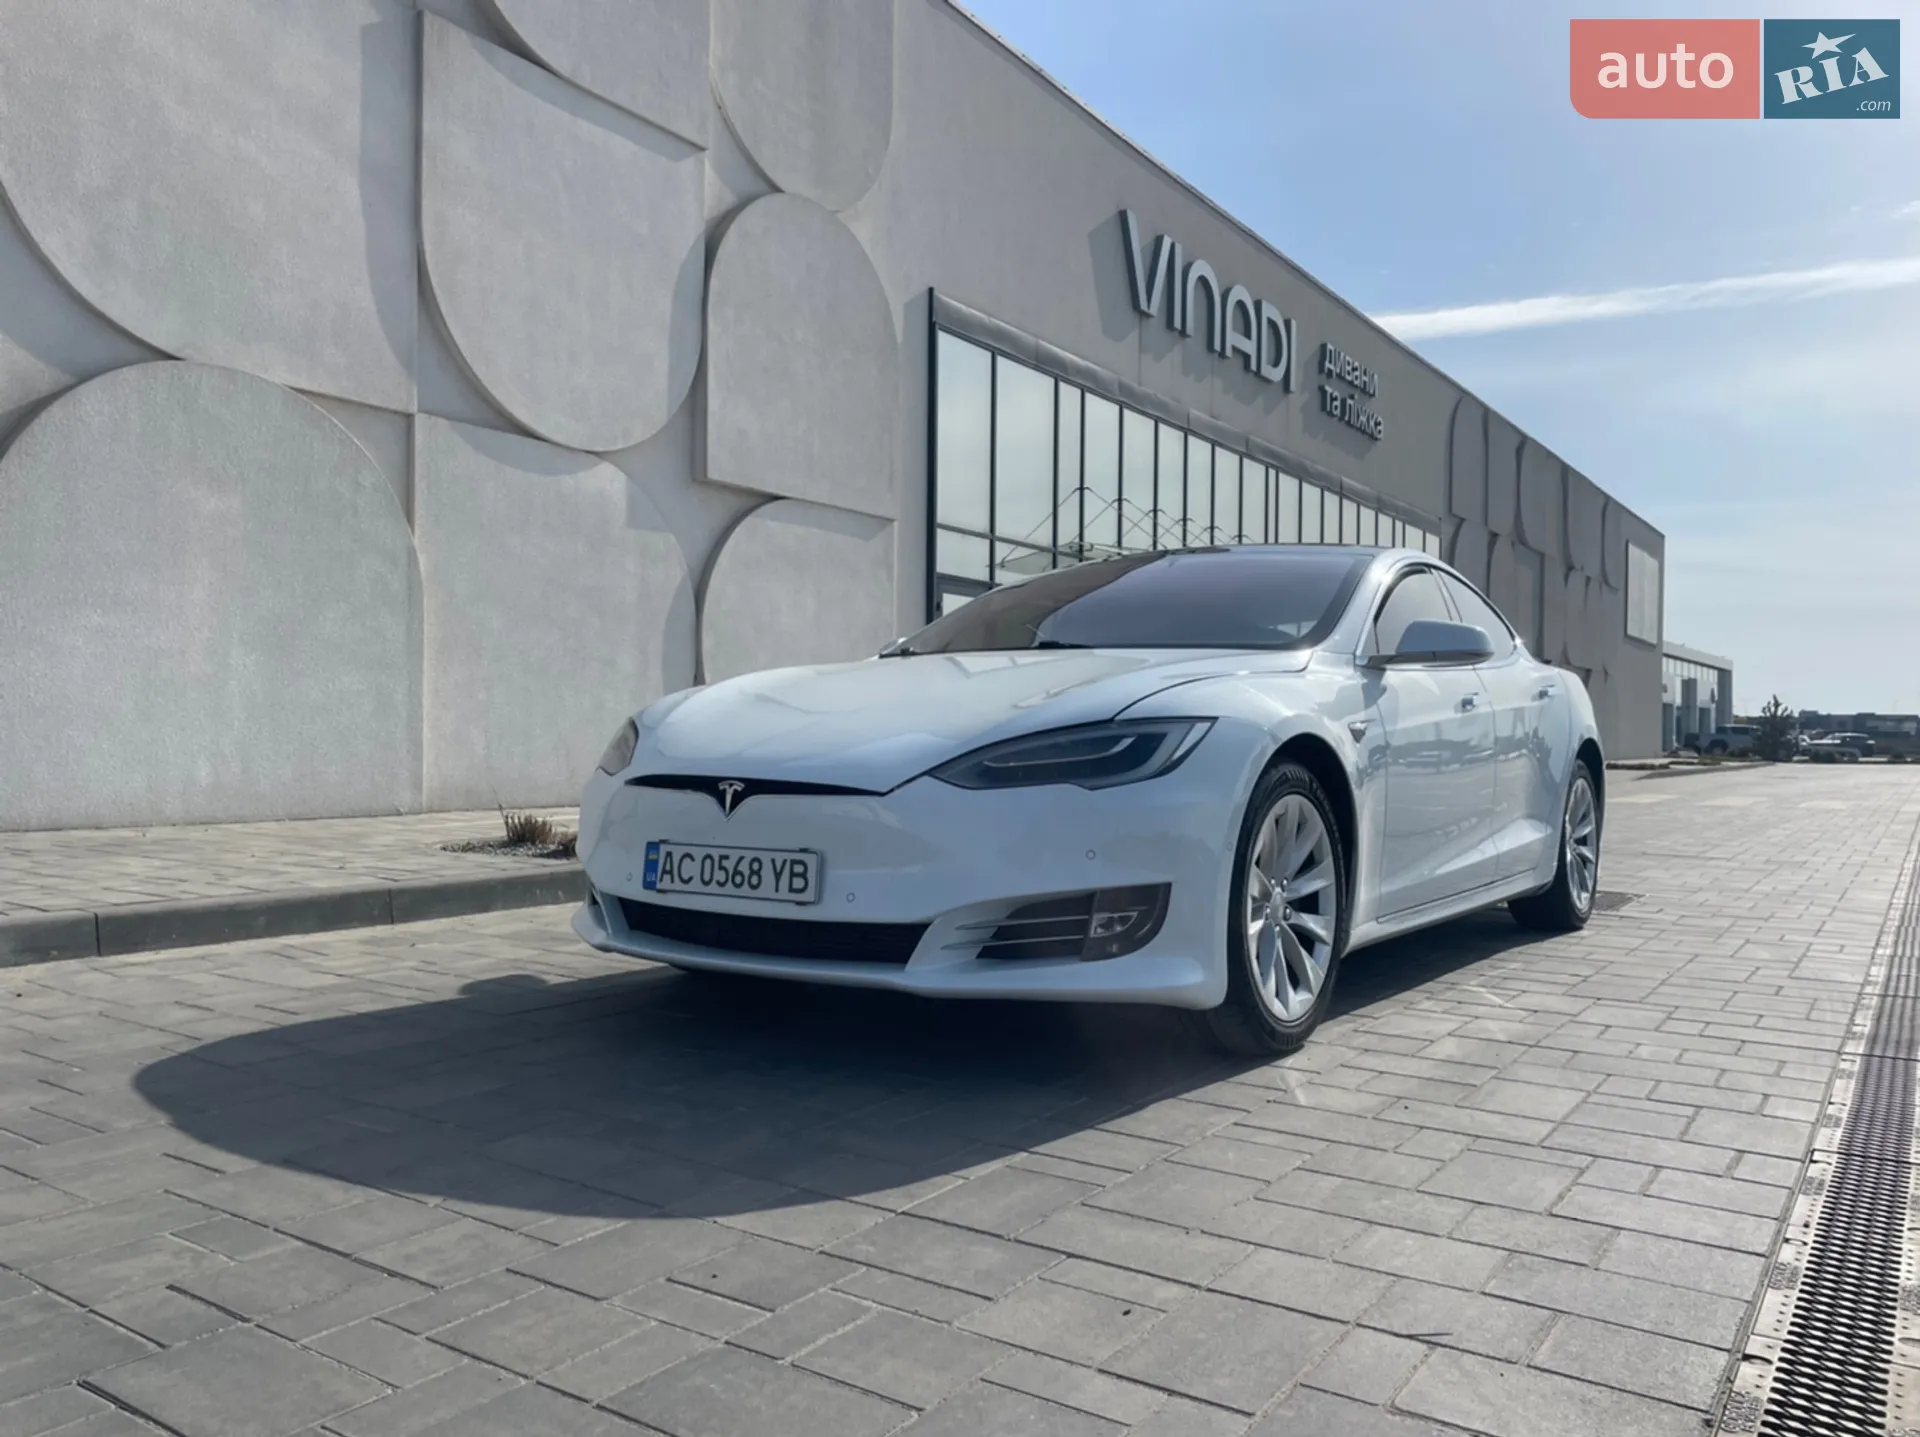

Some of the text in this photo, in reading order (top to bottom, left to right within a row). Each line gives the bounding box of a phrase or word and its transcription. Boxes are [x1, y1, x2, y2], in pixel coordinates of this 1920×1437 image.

[1119, 209, 1297, 394] VINADI
[1322, 342, 1379, 398] дивани
[1322, 385, 1385, 442] та ліжка
[659, 851, 810, 895] AC 0568 YB
